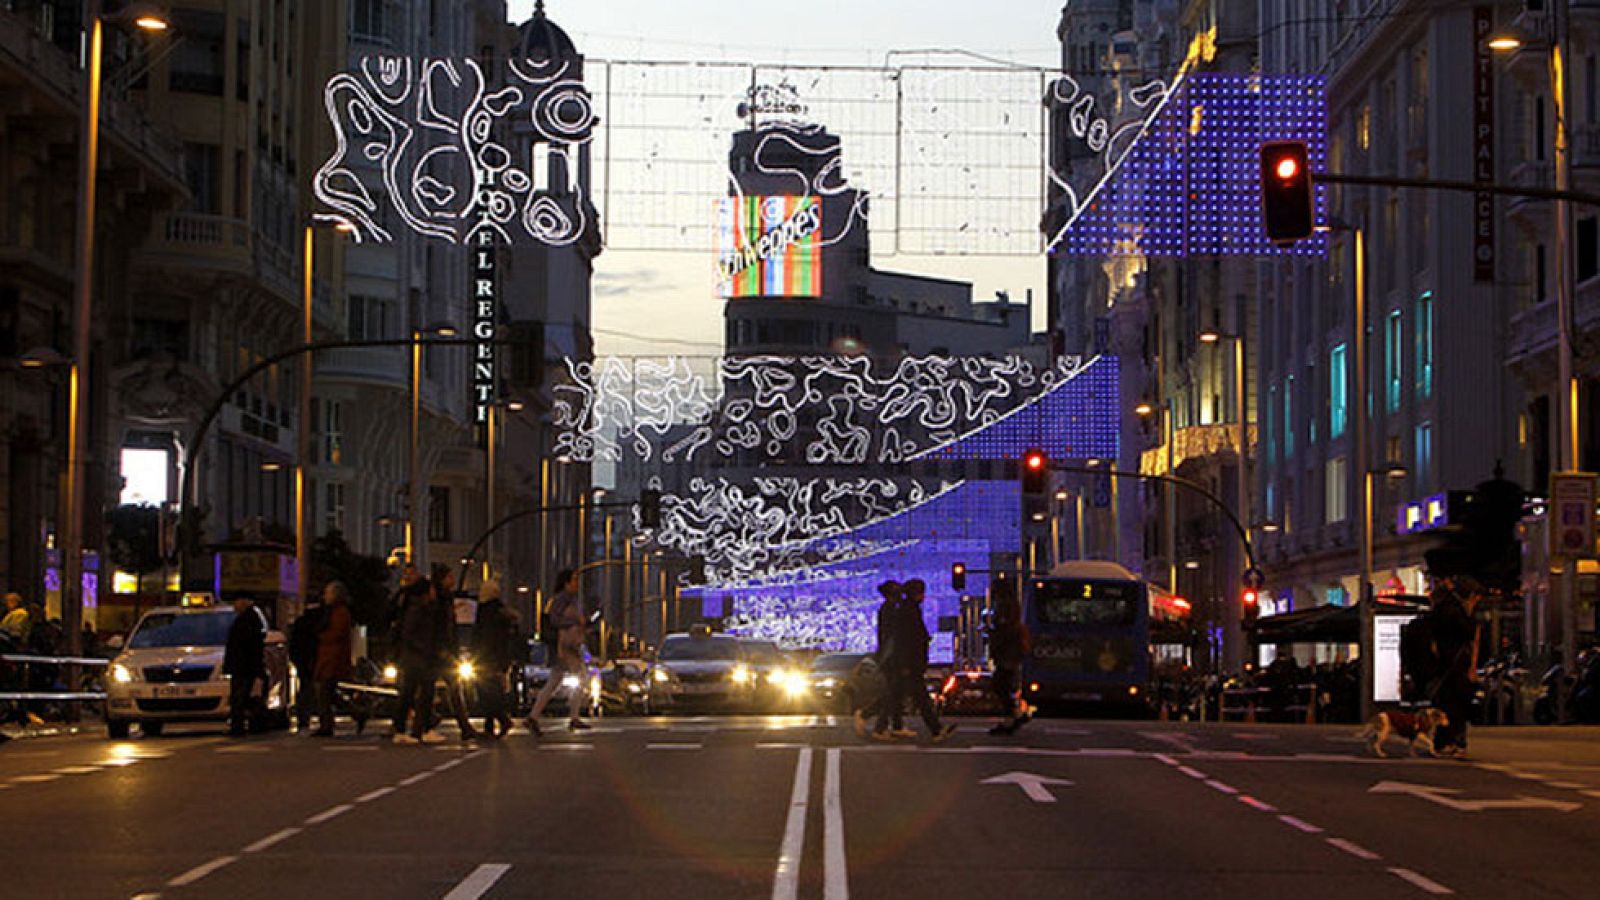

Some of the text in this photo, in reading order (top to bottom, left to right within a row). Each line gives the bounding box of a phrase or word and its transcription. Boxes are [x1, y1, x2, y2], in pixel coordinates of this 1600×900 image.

[1477, 18, 1492, 112] PETIT
[475, 169, 495, 269] HOTEL
[718, 203, 820, 281] chweppes
